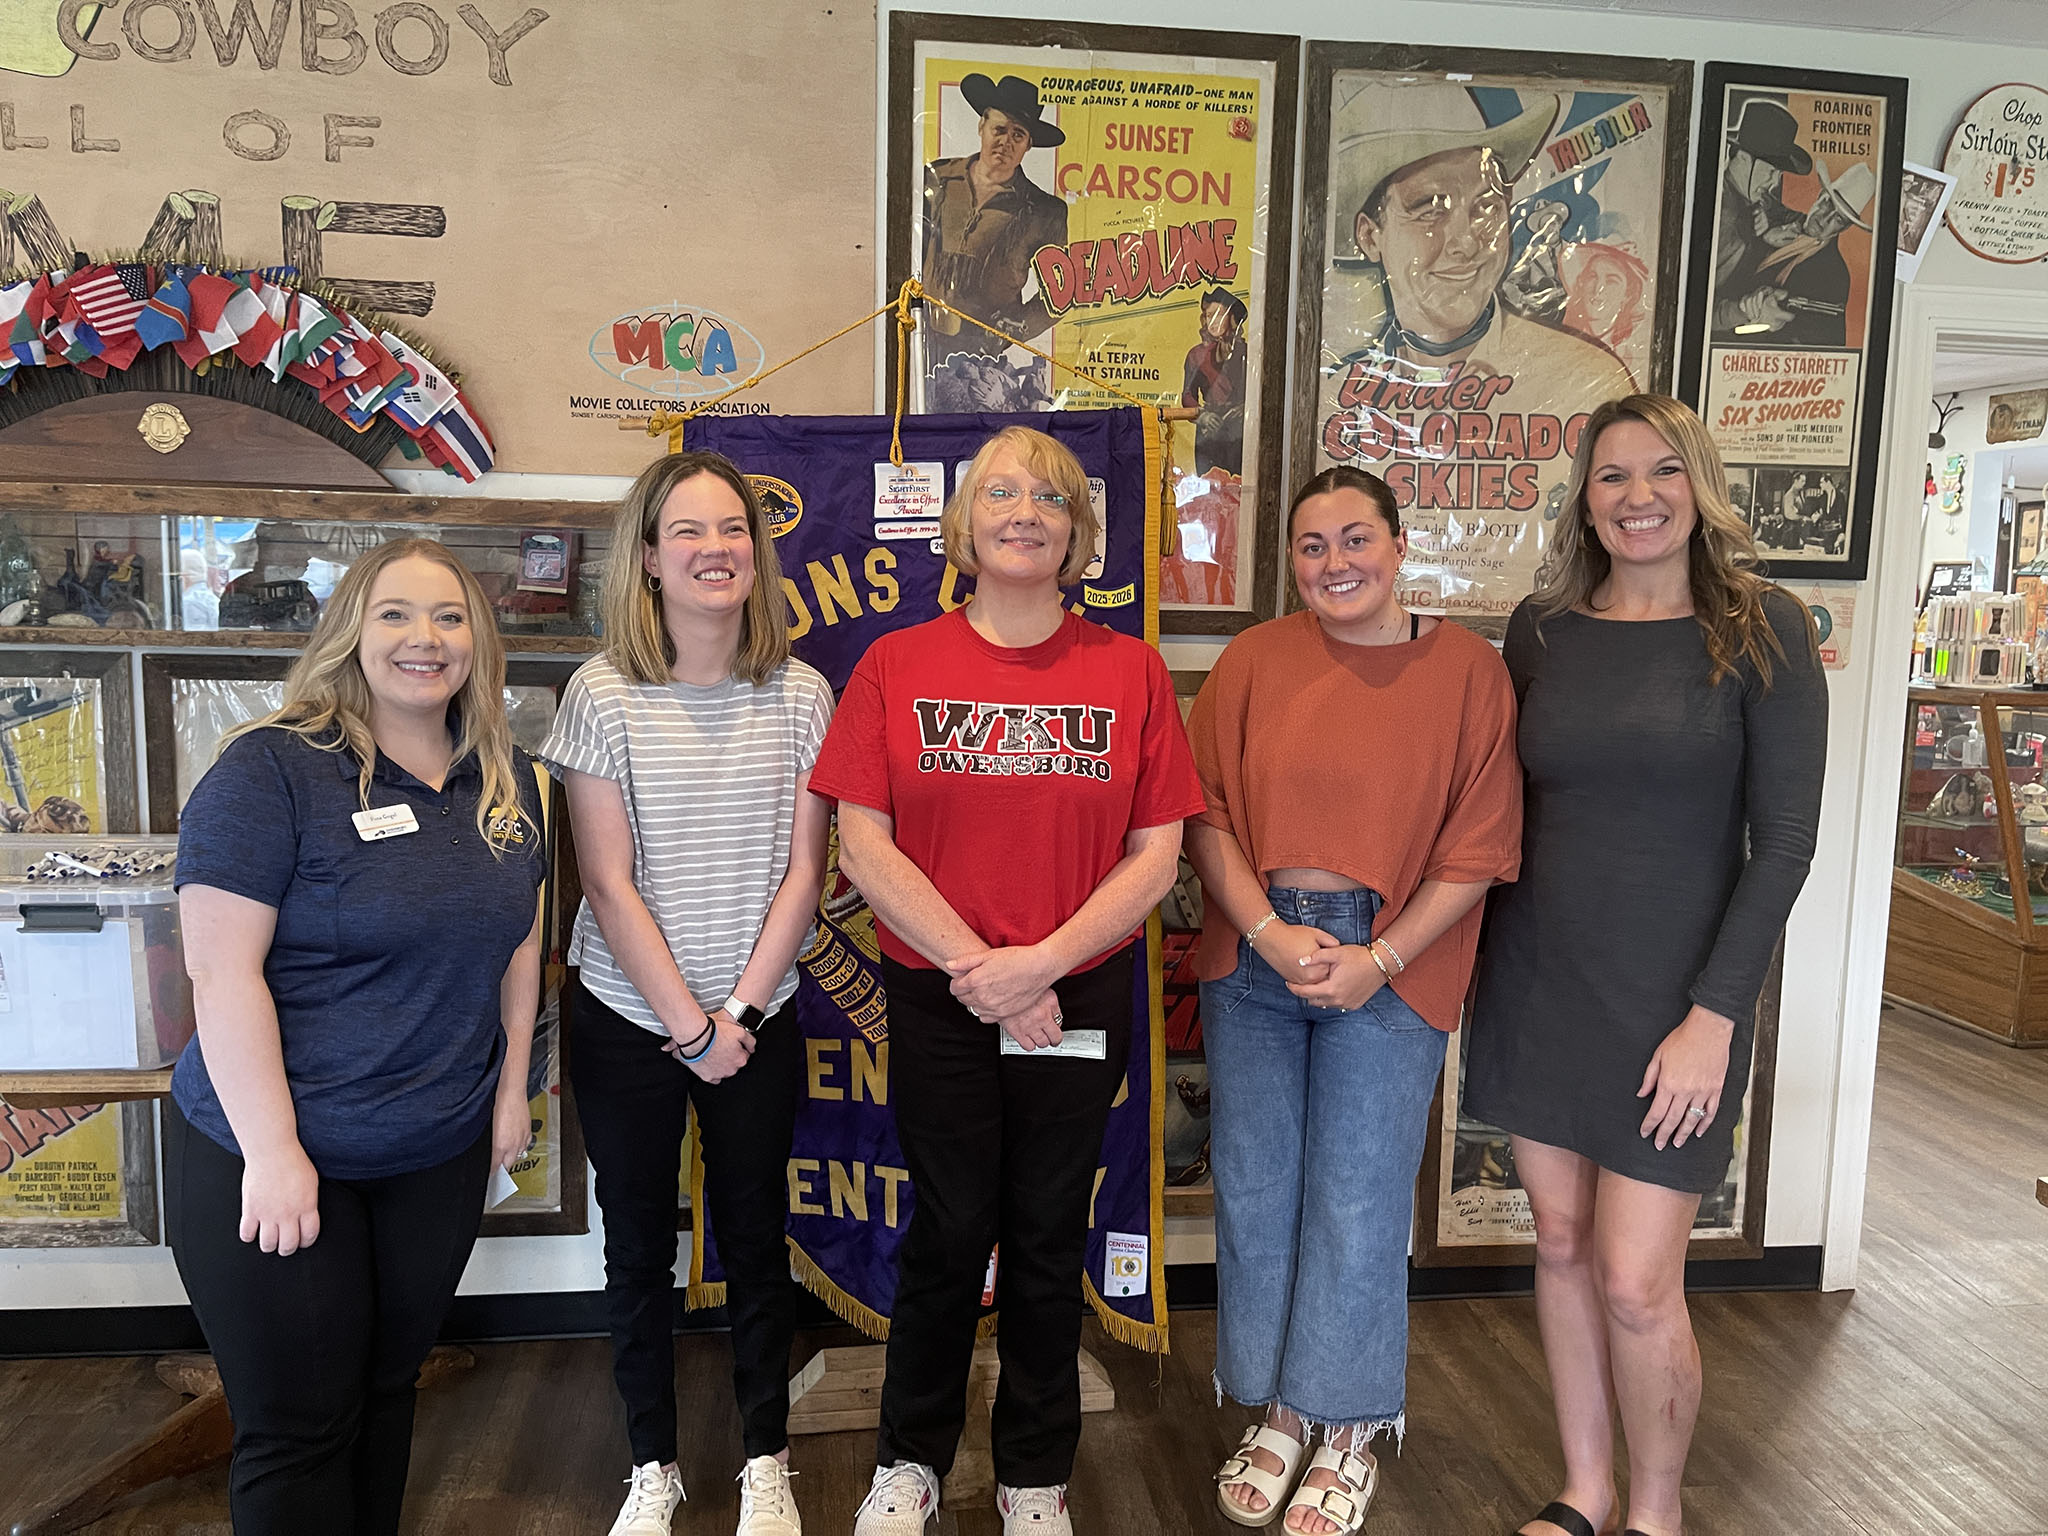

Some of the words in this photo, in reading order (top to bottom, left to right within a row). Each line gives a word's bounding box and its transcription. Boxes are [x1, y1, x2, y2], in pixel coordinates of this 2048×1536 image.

[57, 0, 550, 86] COWBOY
[1040, 76, 1126, 94] COURAGEOUS,
[1228, 89, 1254, 100] MAN
[1040, 94, 1076, 106] ALONE
[1081, 96, 1128, 107] AGAINST
[1132, 98, 1140, 107] A
[1145, 99, 1181, 110] HORDE
[1186, 100, 1200, 111] OF
[1204, 101, 1254, 114] KILLERS!
[1813, 100, 1873, 117] ROARING
[2003, 99, 2042, 130] Chop
[223, 109, 381, 162] OF
[1104, 123, 1194, 155] SUNSET
[1546, 101, 1653, 173] TRUCOLOR
[1812, 119, 1872, 137] FRONTIER
[1811, 138, 1870, 156] THRILLS!
[1961, 123, 2018, 156] Sirloin
[2026, 134, 2048, 161] St
[1057, 162, 1232, 206] CARSON
[1958, 200, 1990, 210] FRENCH
[1974, 226, 2008, 236] COTTAGE
[1980, 215, 1995, 223] TEA
[1033, 219, 1239, 318] DEADLINE
[613, 313, 738, 377] MCA
[1088, 351, 1104, 363] AL
[1107, 352, 1146, 364] TERRY
[1722, 354, 1780, 374] CHARLES
[1783, 357, 1849, 376] STARRETT
[1074, 366, 1096, 379] PAT
[1101, 366, 1160, 381] STARLING
[1339, 359, 1514, 411] Under
[1740, 377, 1826, 401] BLAZING
[570, 396, 612, 410] MOVIE
[616, 398, 687, 414] COLLECTORS
[690, 400, 771, 415] ASSOCIATION
[1719, 405, 1754, 427] SIX
[1754, 399, 1846, 424] SHOOTERS
[1322, 412, 1592, 462] COLORADO
[1756, 433, 1774, 442] SONS
[1787, 435, 1799, 443] THE
[1801, 435, 1834, 444] PIONEERS
[1794, 424, 1807, 433] IRIS
[1810, 424, 1843, 433] MEREDITH
[1384, 462, 1540, 512] SKIES
[1441, 557, 1476, 570] Purple
[1480, 557, 1505, 570] Sage
[1087, 588, 1132, 605] 2025-2026
[913, 698, 1116, 756] WKU
[918, 751, 1111, 783] OWENSBORO
[811, 945, 844, 975] 2000-01
[821, 957, 856, 988] 2001-02
[836, 973, 871, 1007] 2002-03
[867, 1022, 887, 1041] 200
[68, 1162, 98, 1171] PATRICK
